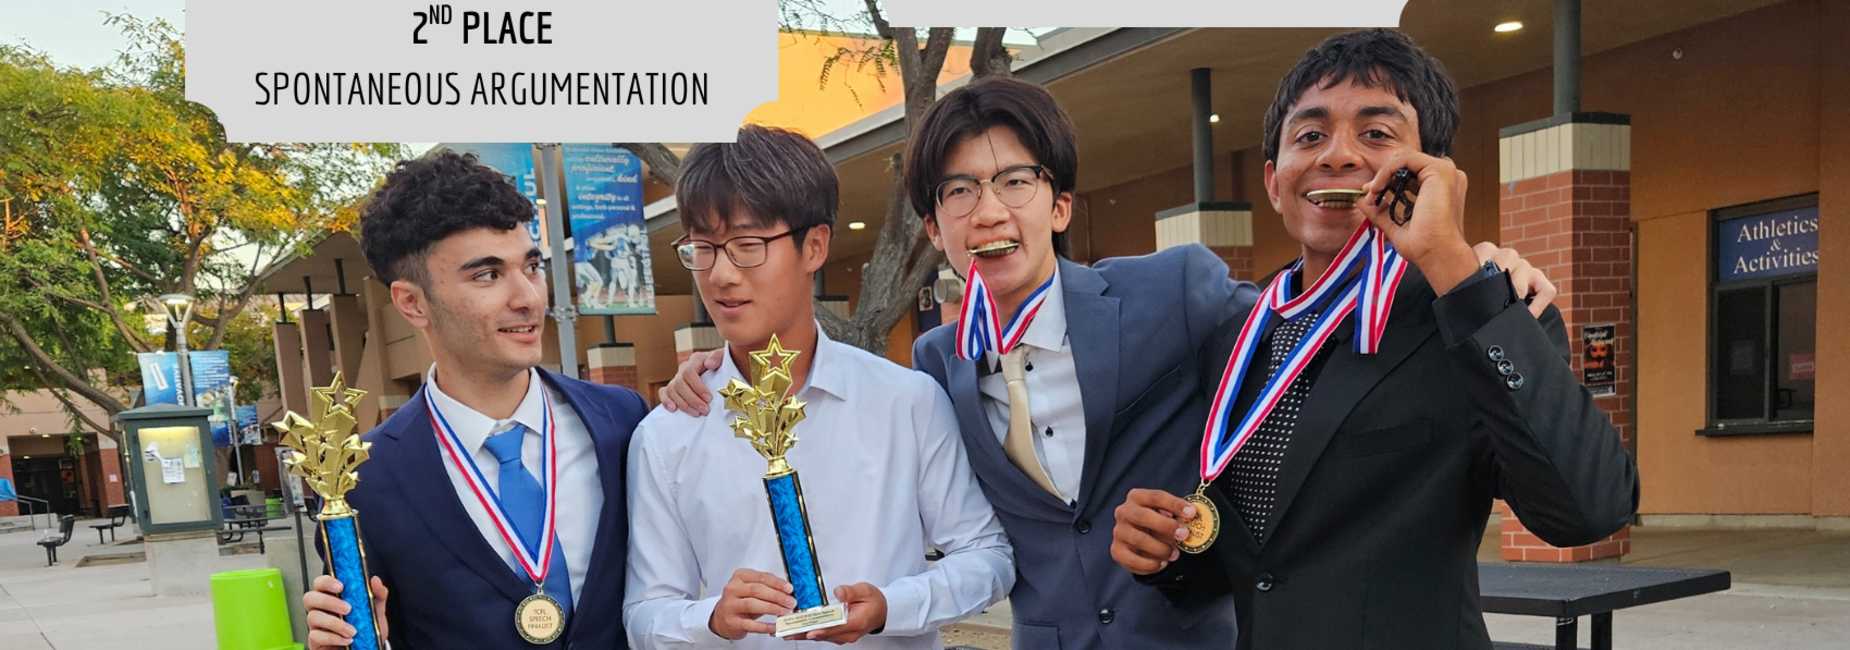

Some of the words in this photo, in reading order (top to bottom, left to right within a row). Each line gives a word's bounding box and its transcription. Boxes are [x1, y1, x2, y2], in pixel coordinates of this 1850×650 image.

[1737, 215, 1818, 243] Athletics
[1770, 239, 1781, 251] &
[1733, 247, 1819, 274] Activities
